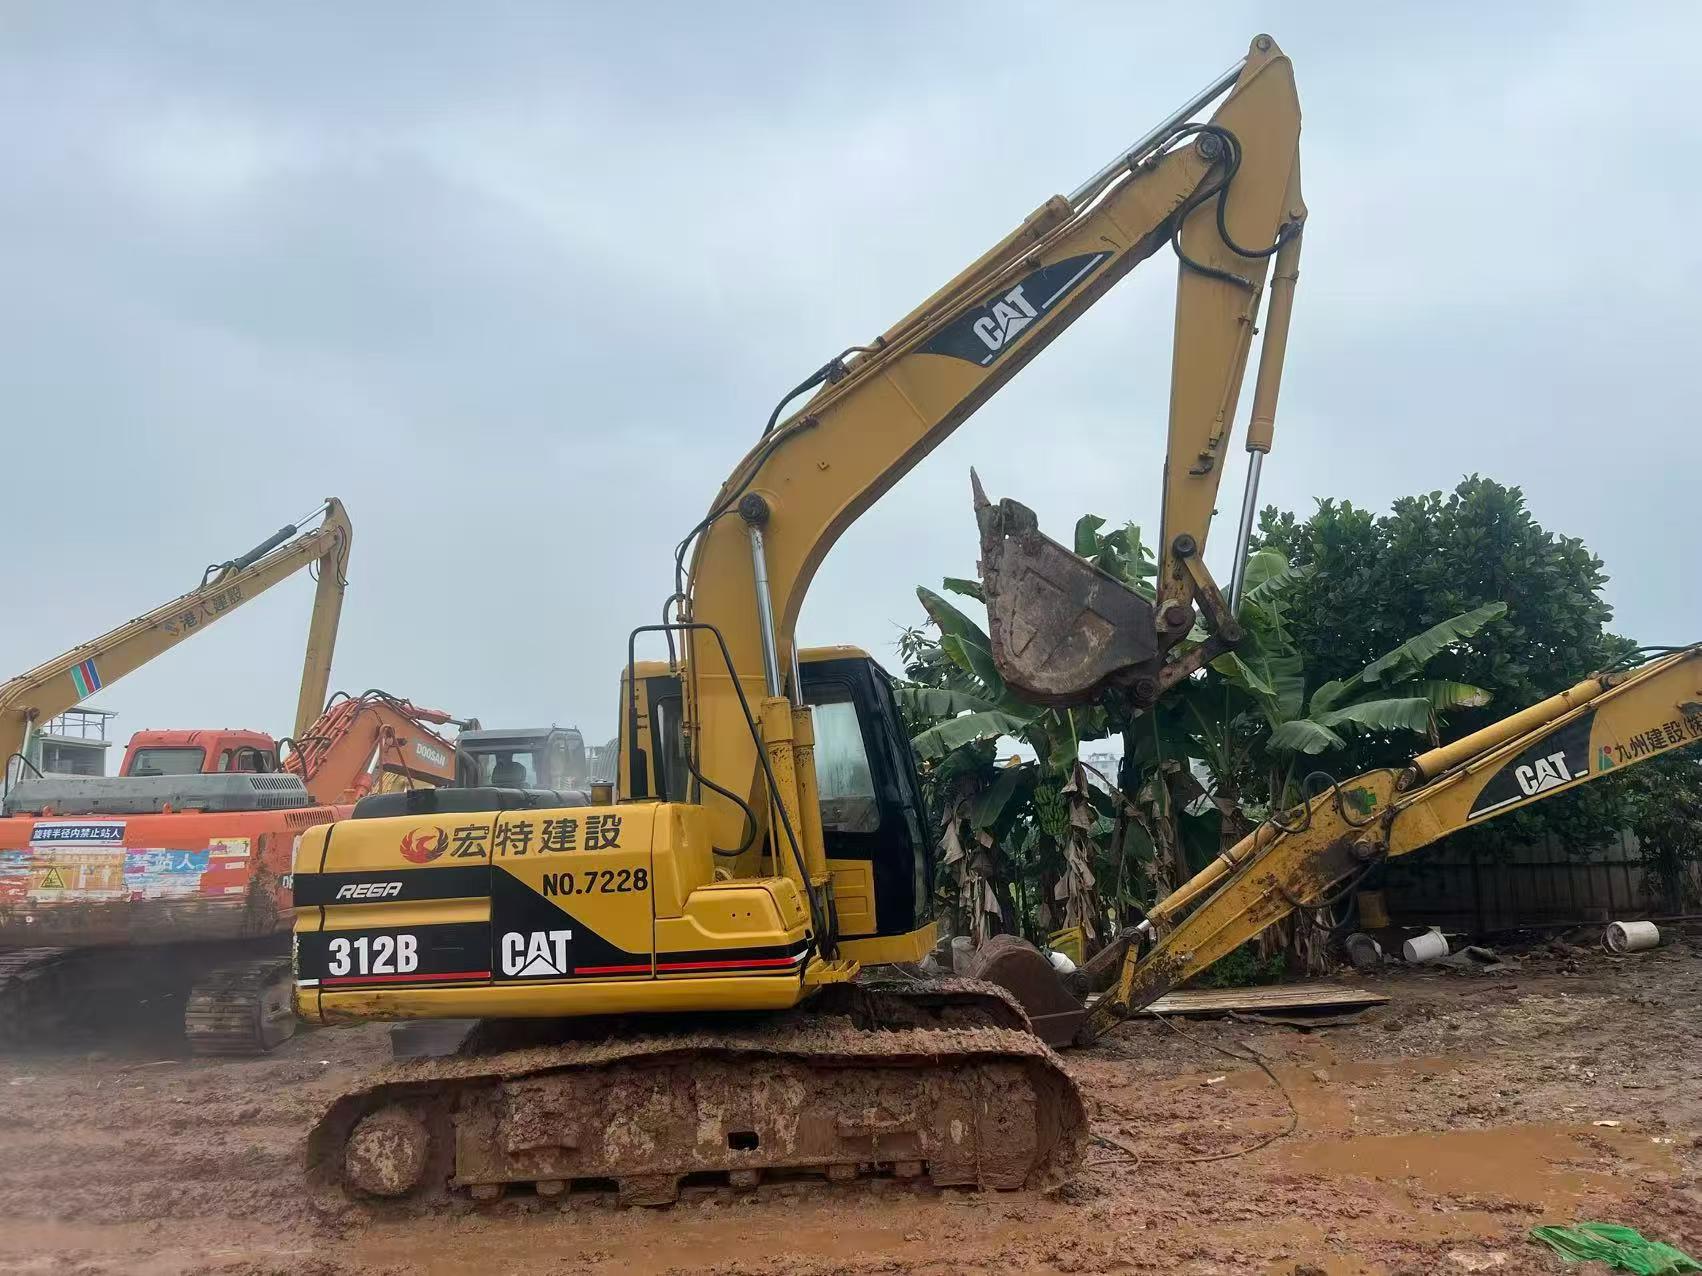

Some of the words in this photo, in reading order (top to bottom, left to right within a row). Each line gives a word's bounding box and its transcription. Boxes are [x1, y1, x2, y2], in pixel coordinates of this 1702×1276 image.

[972, 284, 1039, 351] CAT
[416, 743, 446, 767] DOOSAN
[1514, 751, 1572, 796] CAT
[33, 828, 120, 839] 旋转半径内禁止站人
[450, 814, 622, 858] 宏特建設
[335, 881, 403, 900] REGA
[542, 868, 648, 896] NO.7228
[328, 934, 419, 976] 312B
[501, 930, 572, 976] CAT
